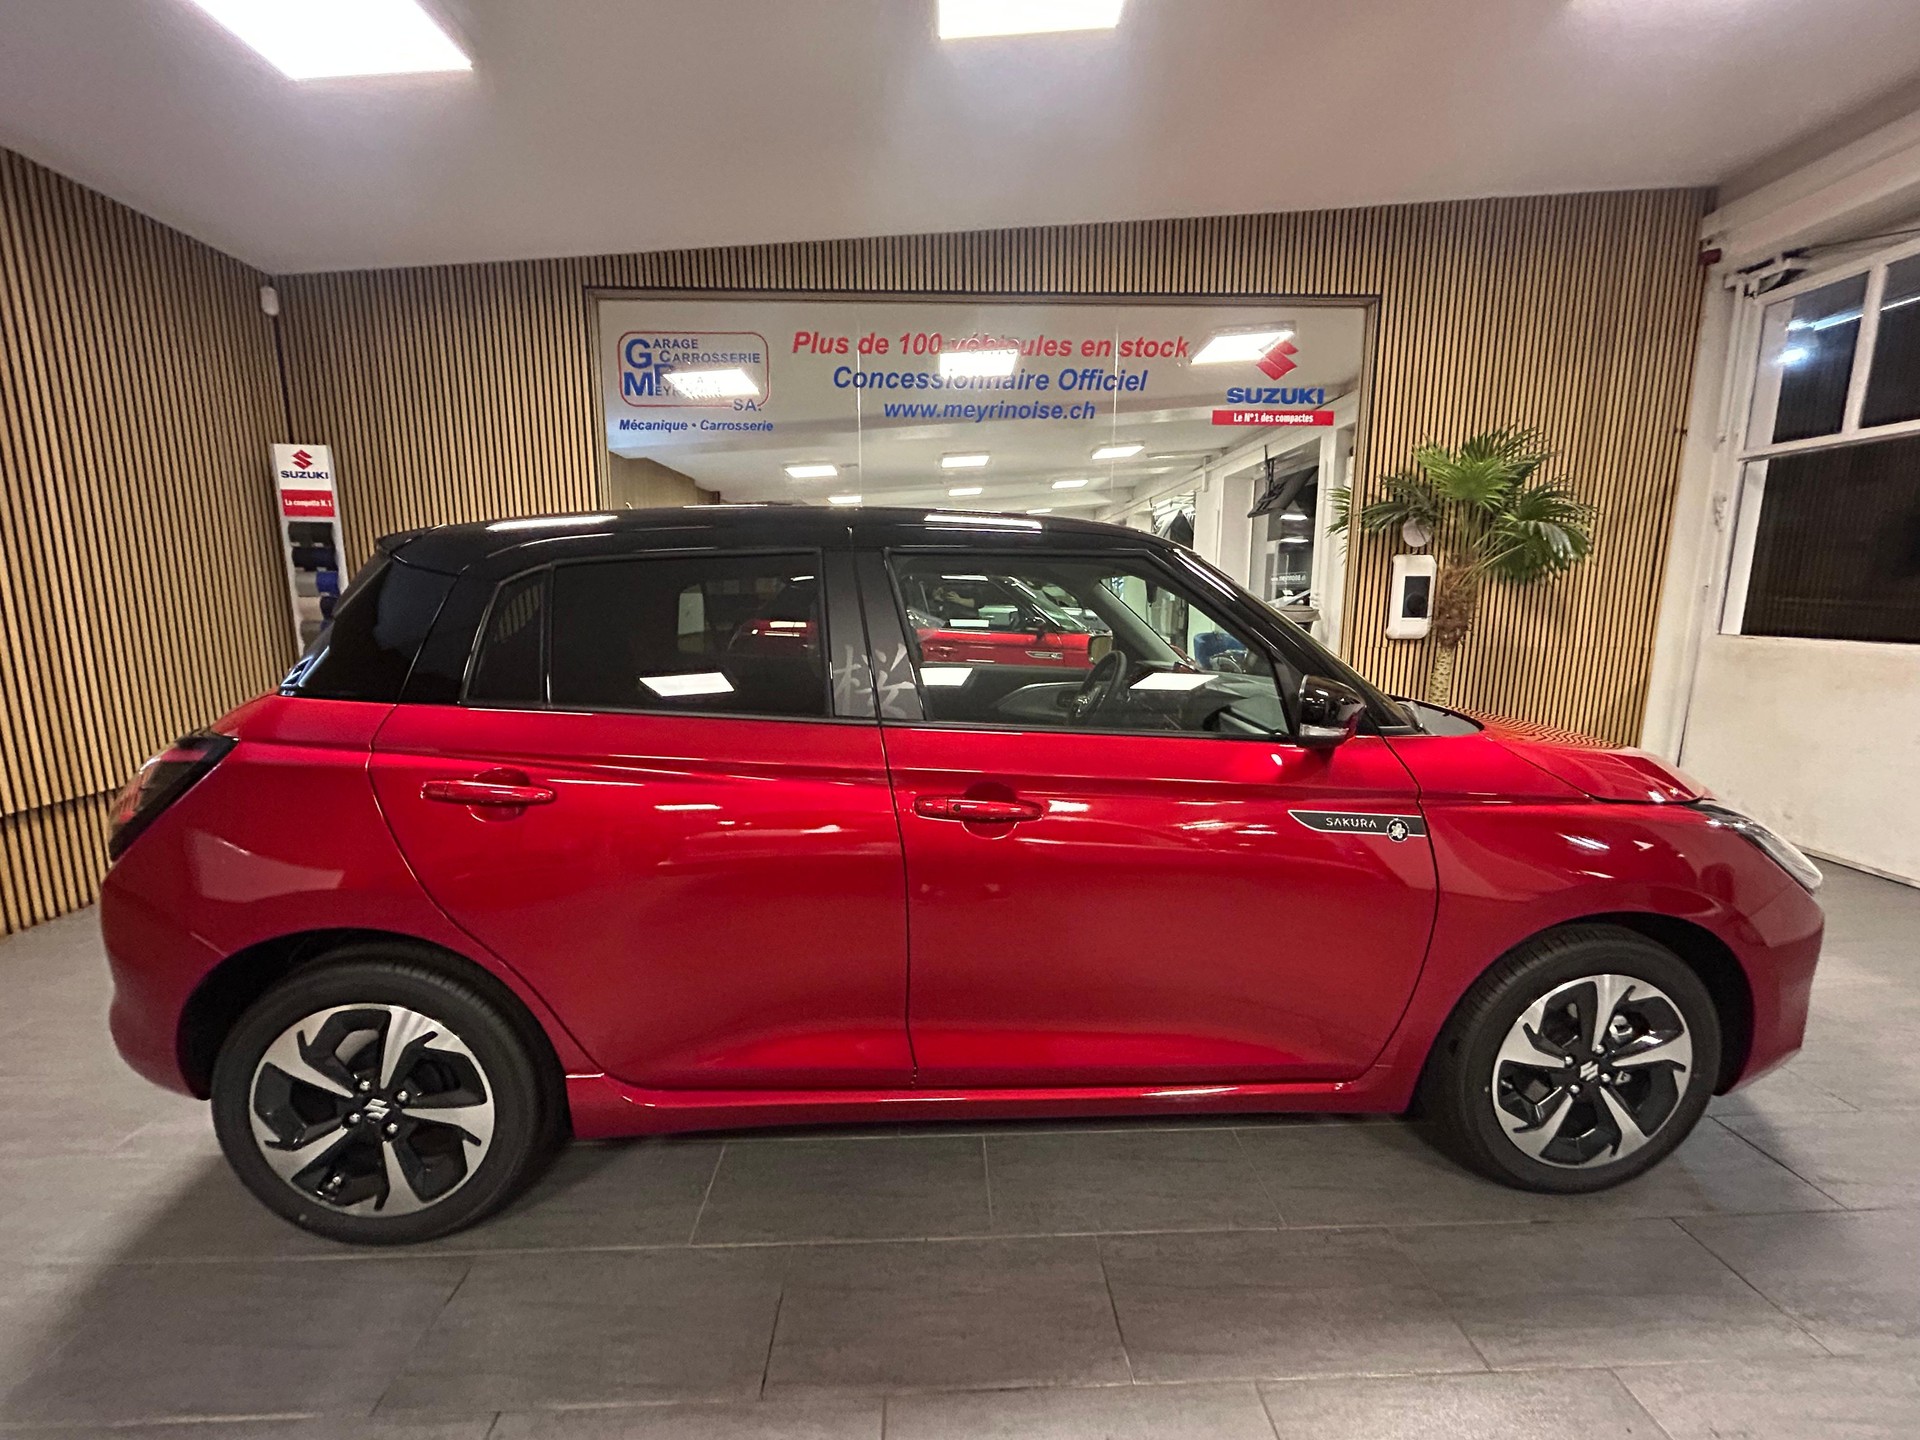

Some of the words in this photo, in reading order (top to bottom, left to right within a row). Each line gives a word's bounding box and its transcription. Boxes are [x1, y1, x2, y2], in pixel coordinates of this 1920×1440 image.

[792, 331, 849, 354] Plus
[858, 332, 889, 355] de
[900, 332, 943, 355] 100
[949, 333, 1073, 357] véhicules
[1080, 339, 1112, 357] en
[1119, 336, 1190, 358] stock
[659, 350, 761, 364] CARROSSERIE
[833, 366, 1050, 391] Concessionnaire
[1058, 368, 1149, 391] Officiel
[1227, 387, 1325, 404] SUZUKI
[733, 399, 762, 412] SA.
[884, 400, 1096, 424] www.meyrinoise.ch
[619, 419, 688, 433] Mécanique
[700, 419, 774, 432] Carrosserie
[1233, 413, 1243, 423] Le
[1261, 413, 1274, 423] des
[1275, 414, 1314, 425] compactes
[280, 470, 329, 479] SUZUKI
[1326, 817, 1377, 829] SAKURA
